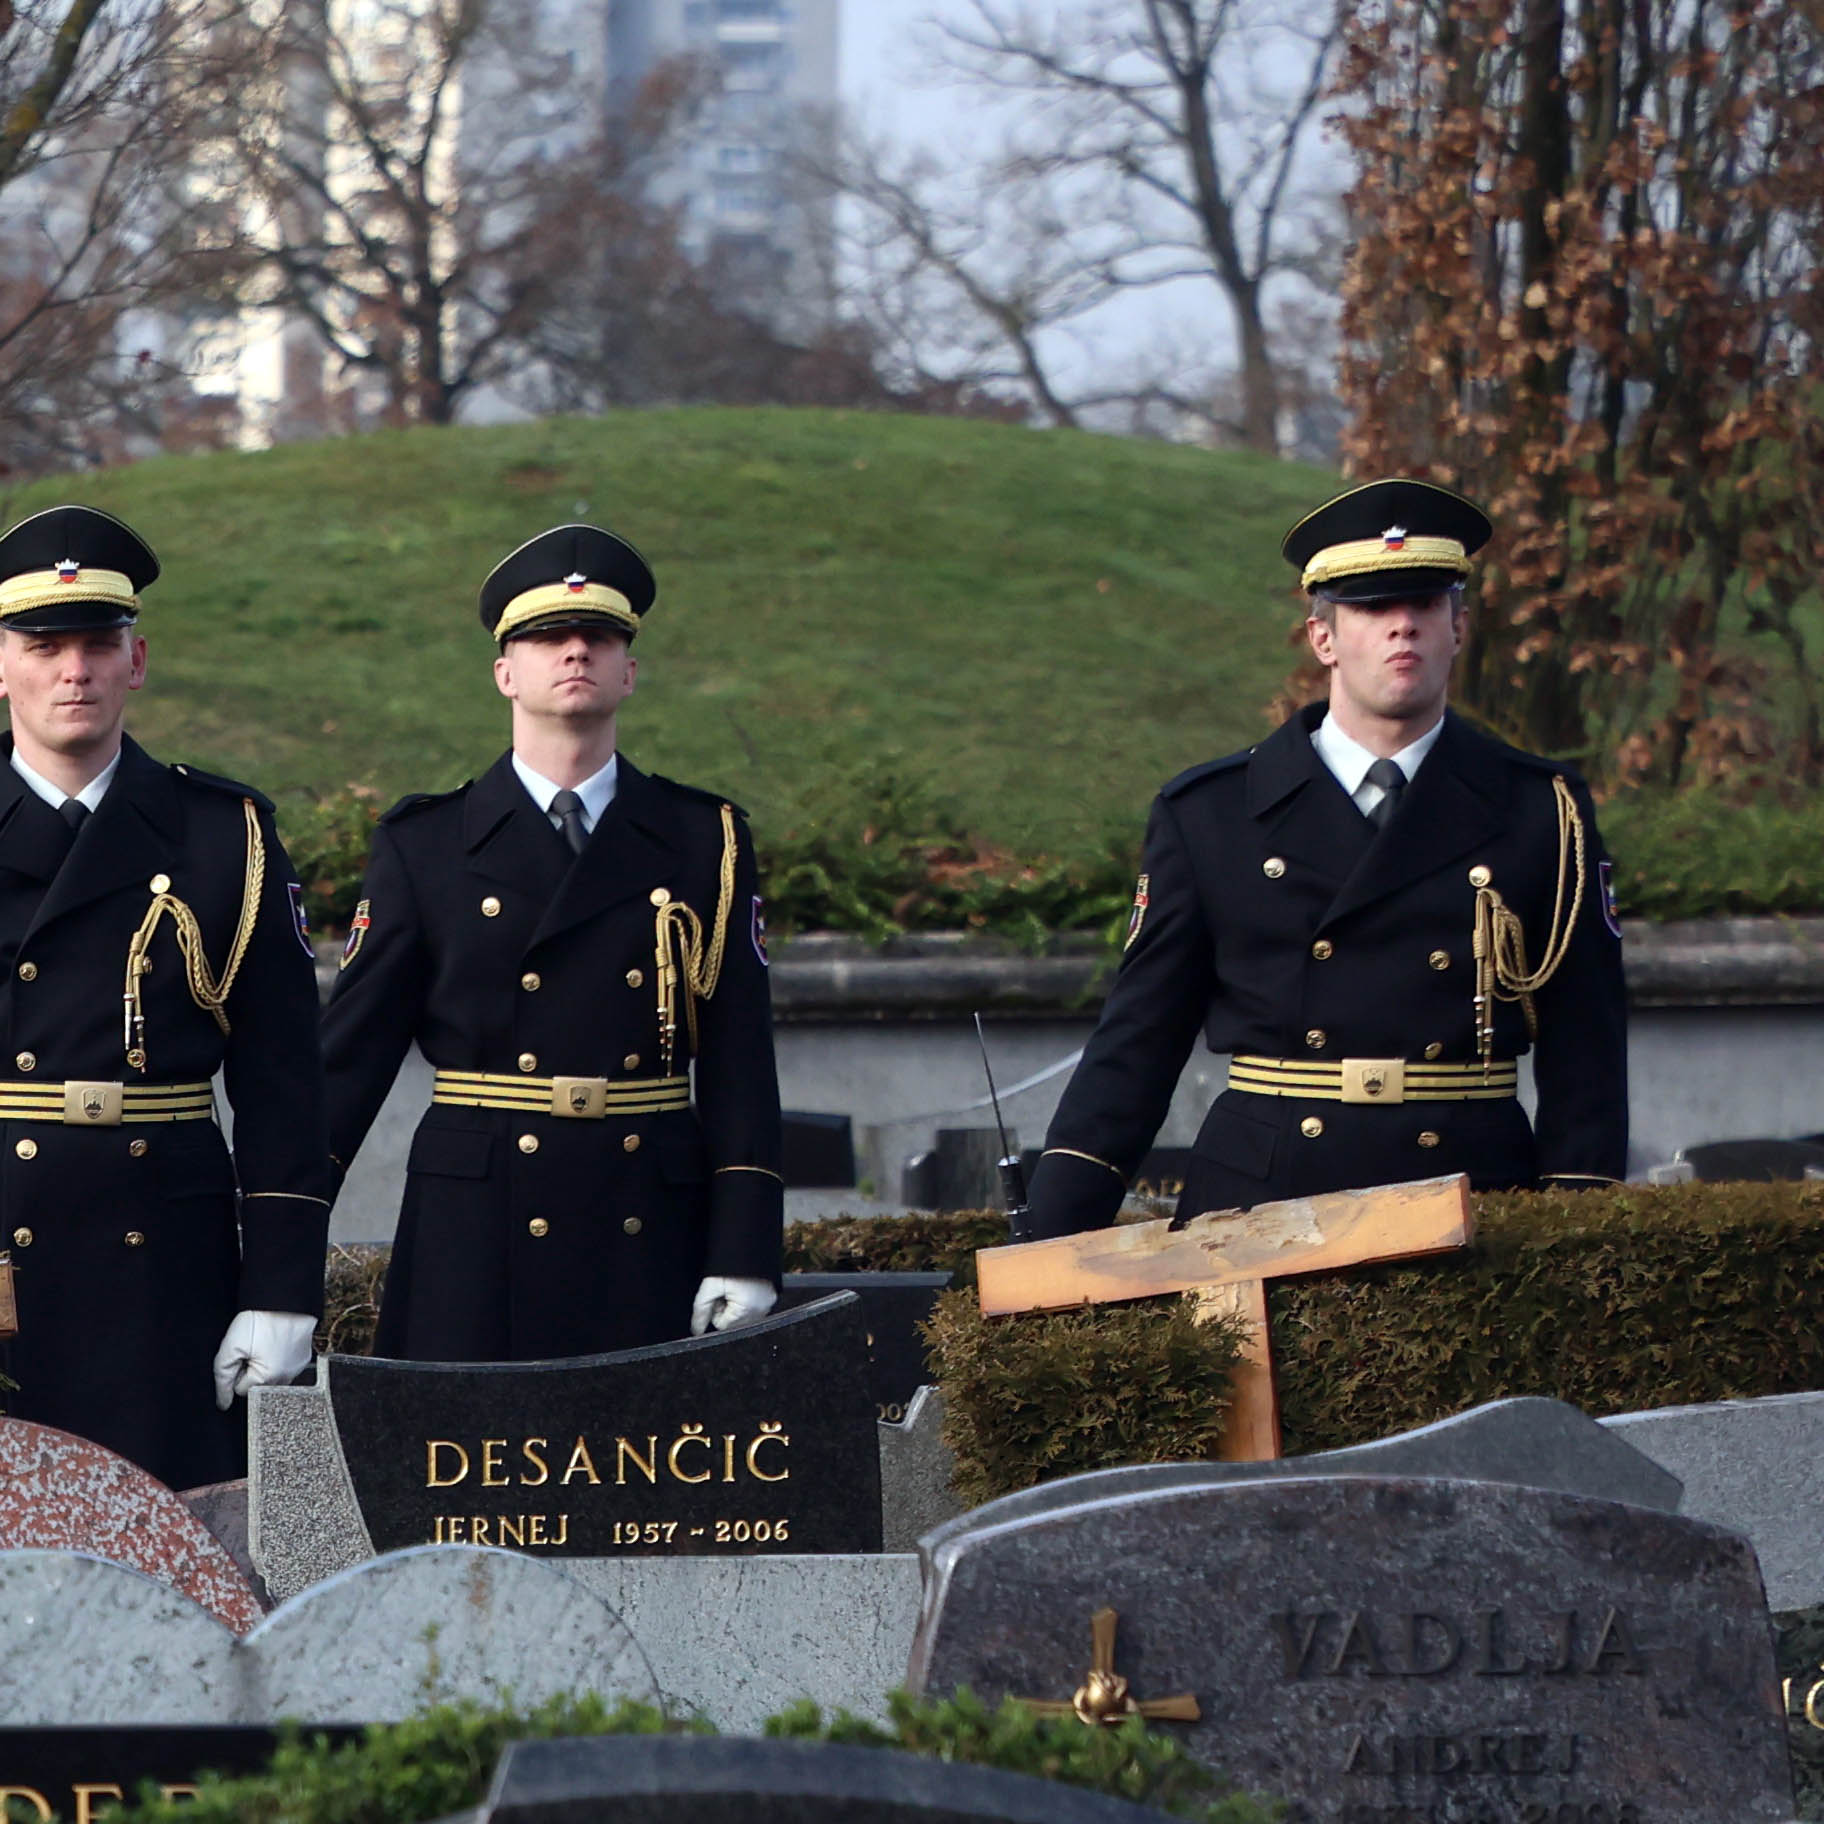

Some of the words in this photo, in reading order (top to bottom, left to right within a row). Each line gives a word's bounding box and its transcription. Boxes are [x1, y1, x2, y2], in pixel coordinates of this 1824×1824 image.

[425, 1420, 791, 1488] DESANČIČ
[430, 1514, 569, 1546] JERNEJ
[612, 1520, 679, 1544] 1957
[714, 1519, 790, 1543] 2006
[1272, 1607, 1645, 1678] VADLJA
